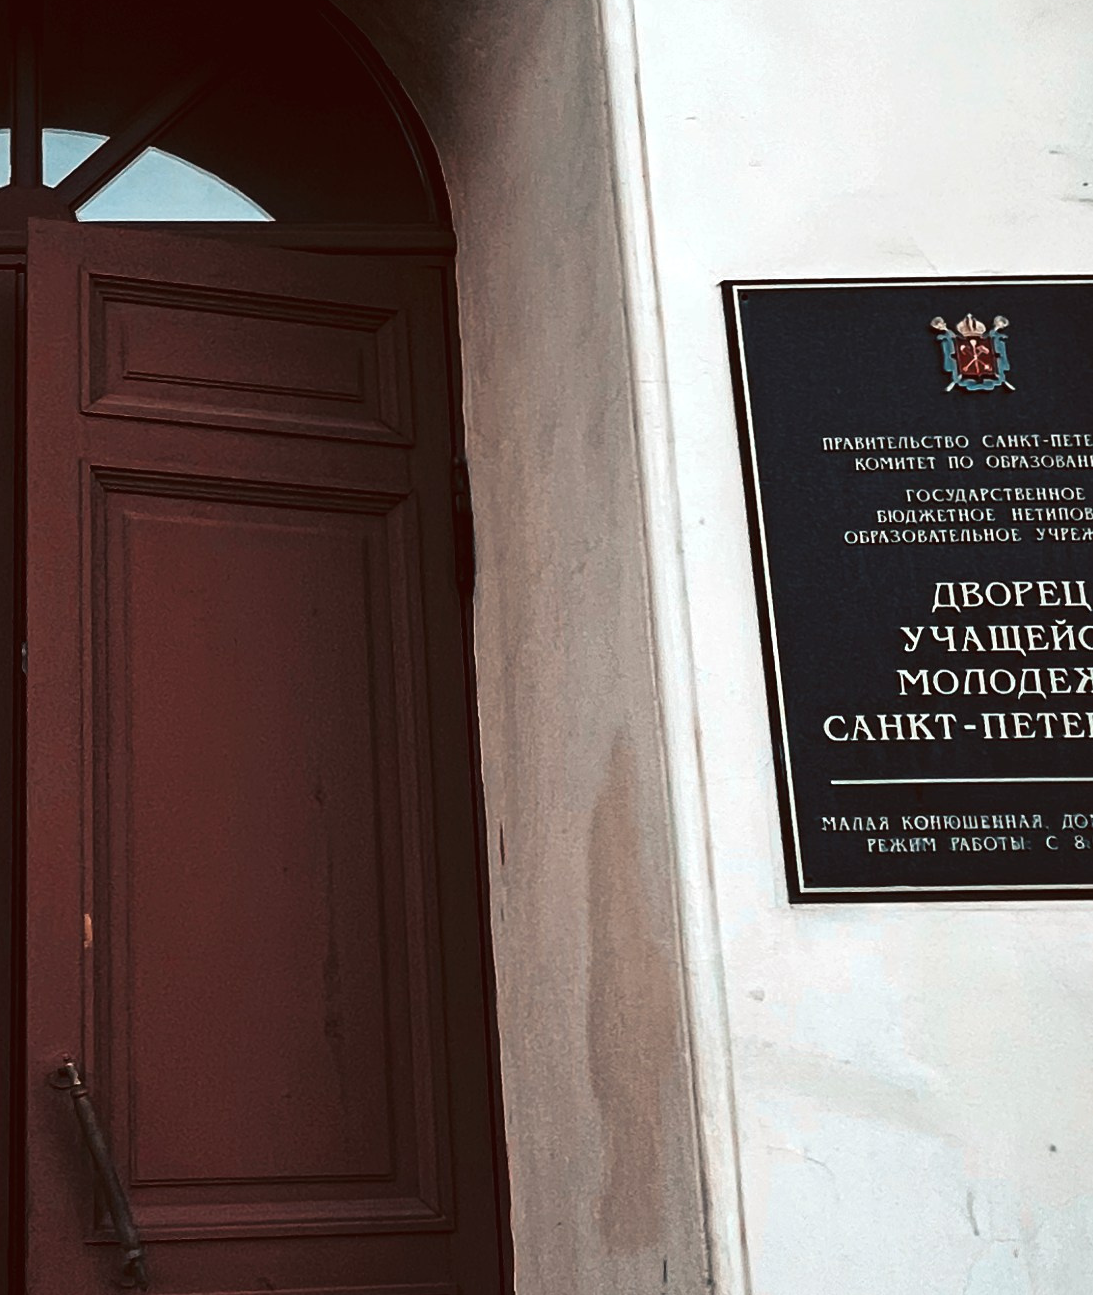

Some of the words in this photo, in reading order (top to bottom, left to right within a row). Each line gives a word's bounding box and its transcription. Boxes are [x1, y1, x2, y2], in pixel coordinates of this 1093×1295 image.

[823, 436, 969, 450] ПРАВИТЕЛЬСТВО
[855, 457, 935, 470] КОМИТЕТ
[948, 456, 973, 468] ПО
[986, 455, 1093, 468] ОБРАЗОВАН
[906, 488, 1085, 503] ГОСУДАРСТВЕННОЕ
[877, 508, 995, 524] БЮДЖЕТНОЕ
[1012, 508, 1093, 521] НЕТИПОВ
[844, 528, 1021, 544] ОБРАЗОВАТЕЛЬНОЕ
[932, 581, 1092, 613] ДВОРЕЦ
[822, 817, 889, 831] МАЛАЯ
[1062, 814, 1093, 829] ДО
[868, 838, 936, 852] РЕЖИМ
[1046, 835, 1059, 850] С
